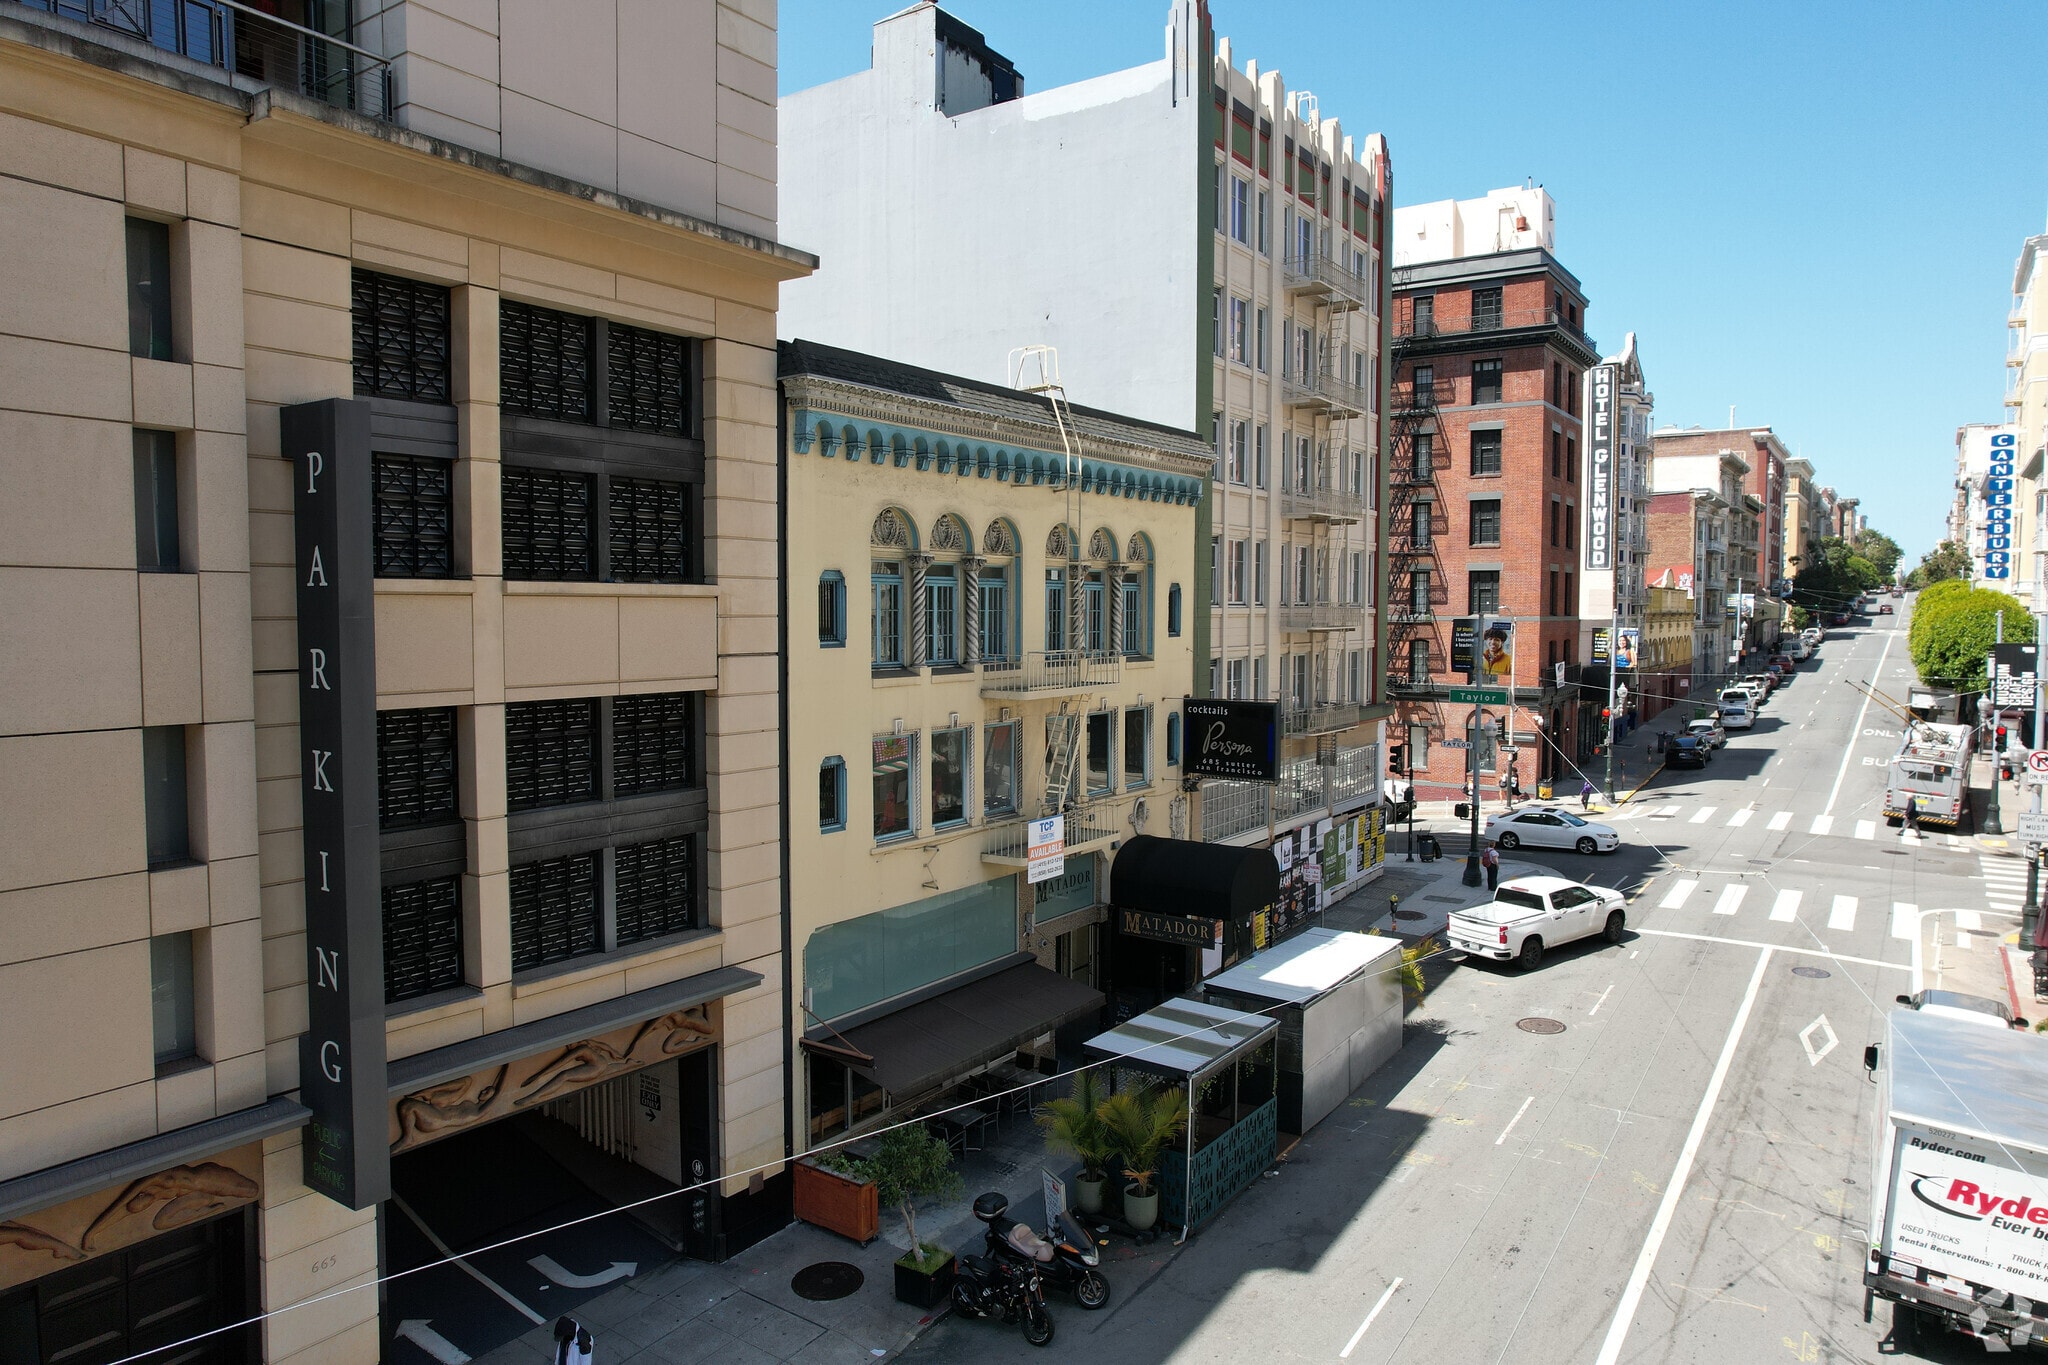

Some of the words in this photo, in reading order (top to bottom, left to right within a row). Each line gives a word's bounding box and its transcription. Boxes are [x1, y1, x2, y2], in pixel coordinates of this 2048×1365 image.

[1594, 368, 1609, 441] HOTEL
[1592, 448, 1608, 565] GLENWOOD
[1992, 435, 2009, 577] CANTERBURY
[1996, 664, 2010, 706] MUSEUM
[2009, 675, 2021, 706] CRAFT
[2021, 671, 2035, 706] DESIGN
[1460, 692, 1497, 702] Taylor
[1187, 705, 1229, 716] cocktails
[1202, 720, 1253, 756] Persona
[306, 451, 342, 1083] PARKING
[1216, 765, 1263, 776] francisco
[1225, 761, 1256, 769] sutter
[1039, 820, 1055, 833] TCP
[1029, 842, 1063, 859] AVAILABLE
[1036, 870, 1091, 904] MATADOR
[1124, 911, 1209, 939] MATADOR
[641, 1097, 659, 1109] ONLY
[642, 1090, 658, 1102] EXIT
[1928, 1127, 1956, 1140] 520272
[1910, 1136, 1986, 1164] Ryder.com
[1901, 1223, 1925, 1236] USED
[1925, 1227, 1961, 1245] TRUCKS
[1991, 1215, 2031, 1235] Ever
[1898, 1235, 1928, 1250] Rental
[1930, 1243, 1995, 1268] Reservations:
[2012, 1253, 2042, 1268] TRUCK
[311, 1254, 337, 1273] 665
